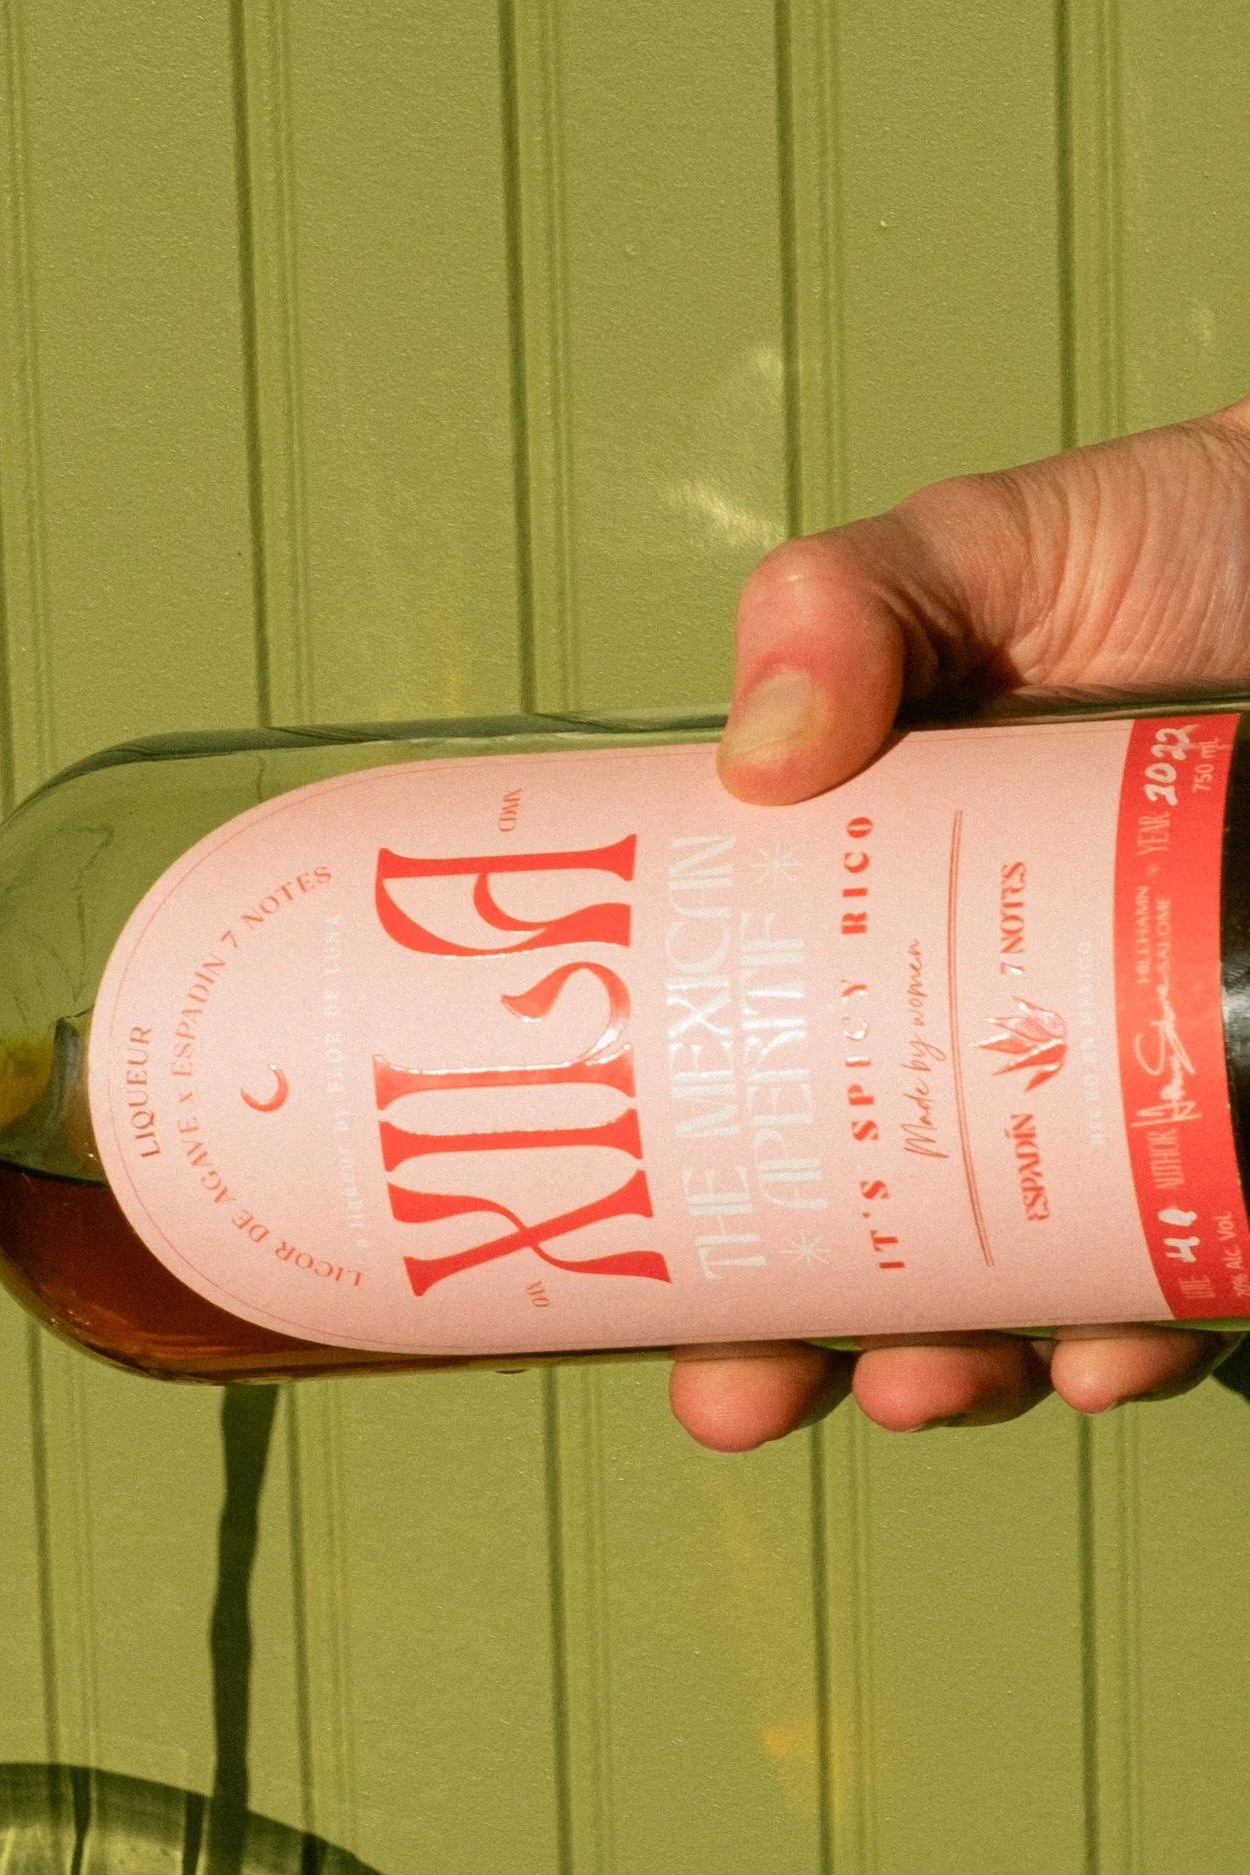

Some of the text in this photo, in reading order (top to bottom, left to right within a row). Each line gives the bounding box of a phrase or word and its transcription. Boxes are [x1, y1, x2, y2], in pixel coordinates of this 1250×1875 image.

[1144, 724, 1196, 806] 2022
[1192, 764, 1214, 793] 750
[1137, 812, 1171, 856] YEAR
[240, 866, 332, 931] NOTES
[1134, 886, 1151, 984] HILLHAMN
[220, 930, 239, 950] 7
[324, 914, 343, 975] LUNA
[324, 992, 341, 1017] DE
[325, 1031, 344, 1094] FLOR
[664, 836, 766, 1280] THE MEXICAN
[739, 912, 828, 1209] APERITIF
[841, 817, 905, 1270] IT'S SPICY RICO
[900, 938, 949, 1159] Made by women
[999, 861, 1049, 1222] ESPADÍN 7 NOTES
[126, 1025, 161, 1159] LIQUEUR
[177, 1116, 236, 1203] AGAVE
[232, 1208, 270, 1244] DE
[275, 1240, 364, 1287] LICOR
